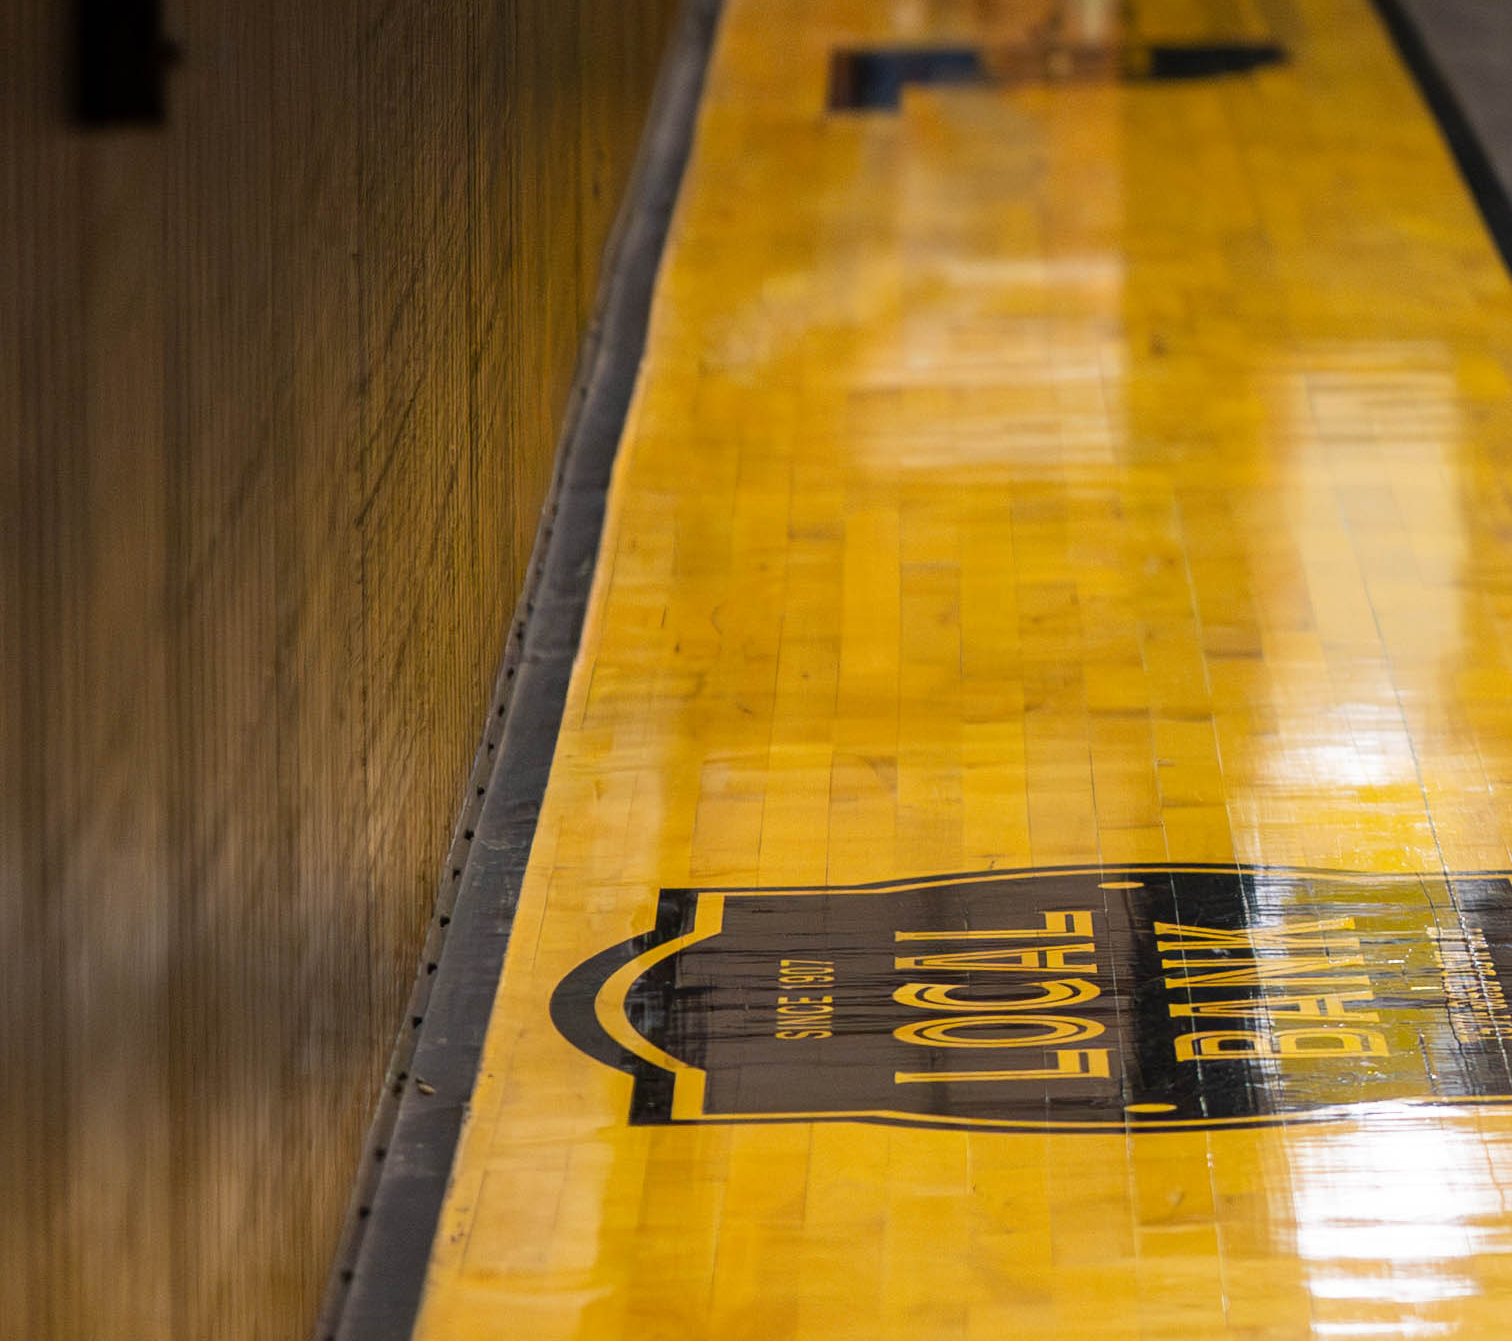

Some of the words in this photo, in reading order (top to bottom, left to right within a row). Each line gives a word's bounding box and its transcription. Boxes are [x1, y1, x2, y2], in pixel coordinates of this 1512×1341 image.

[776, 995, 834, 1039] SINCE
[779, 959, 836, 989] 1907
[892, 910, 1110, 1085] LOCAL
[1153, 917, 1391, 1063] BANK
